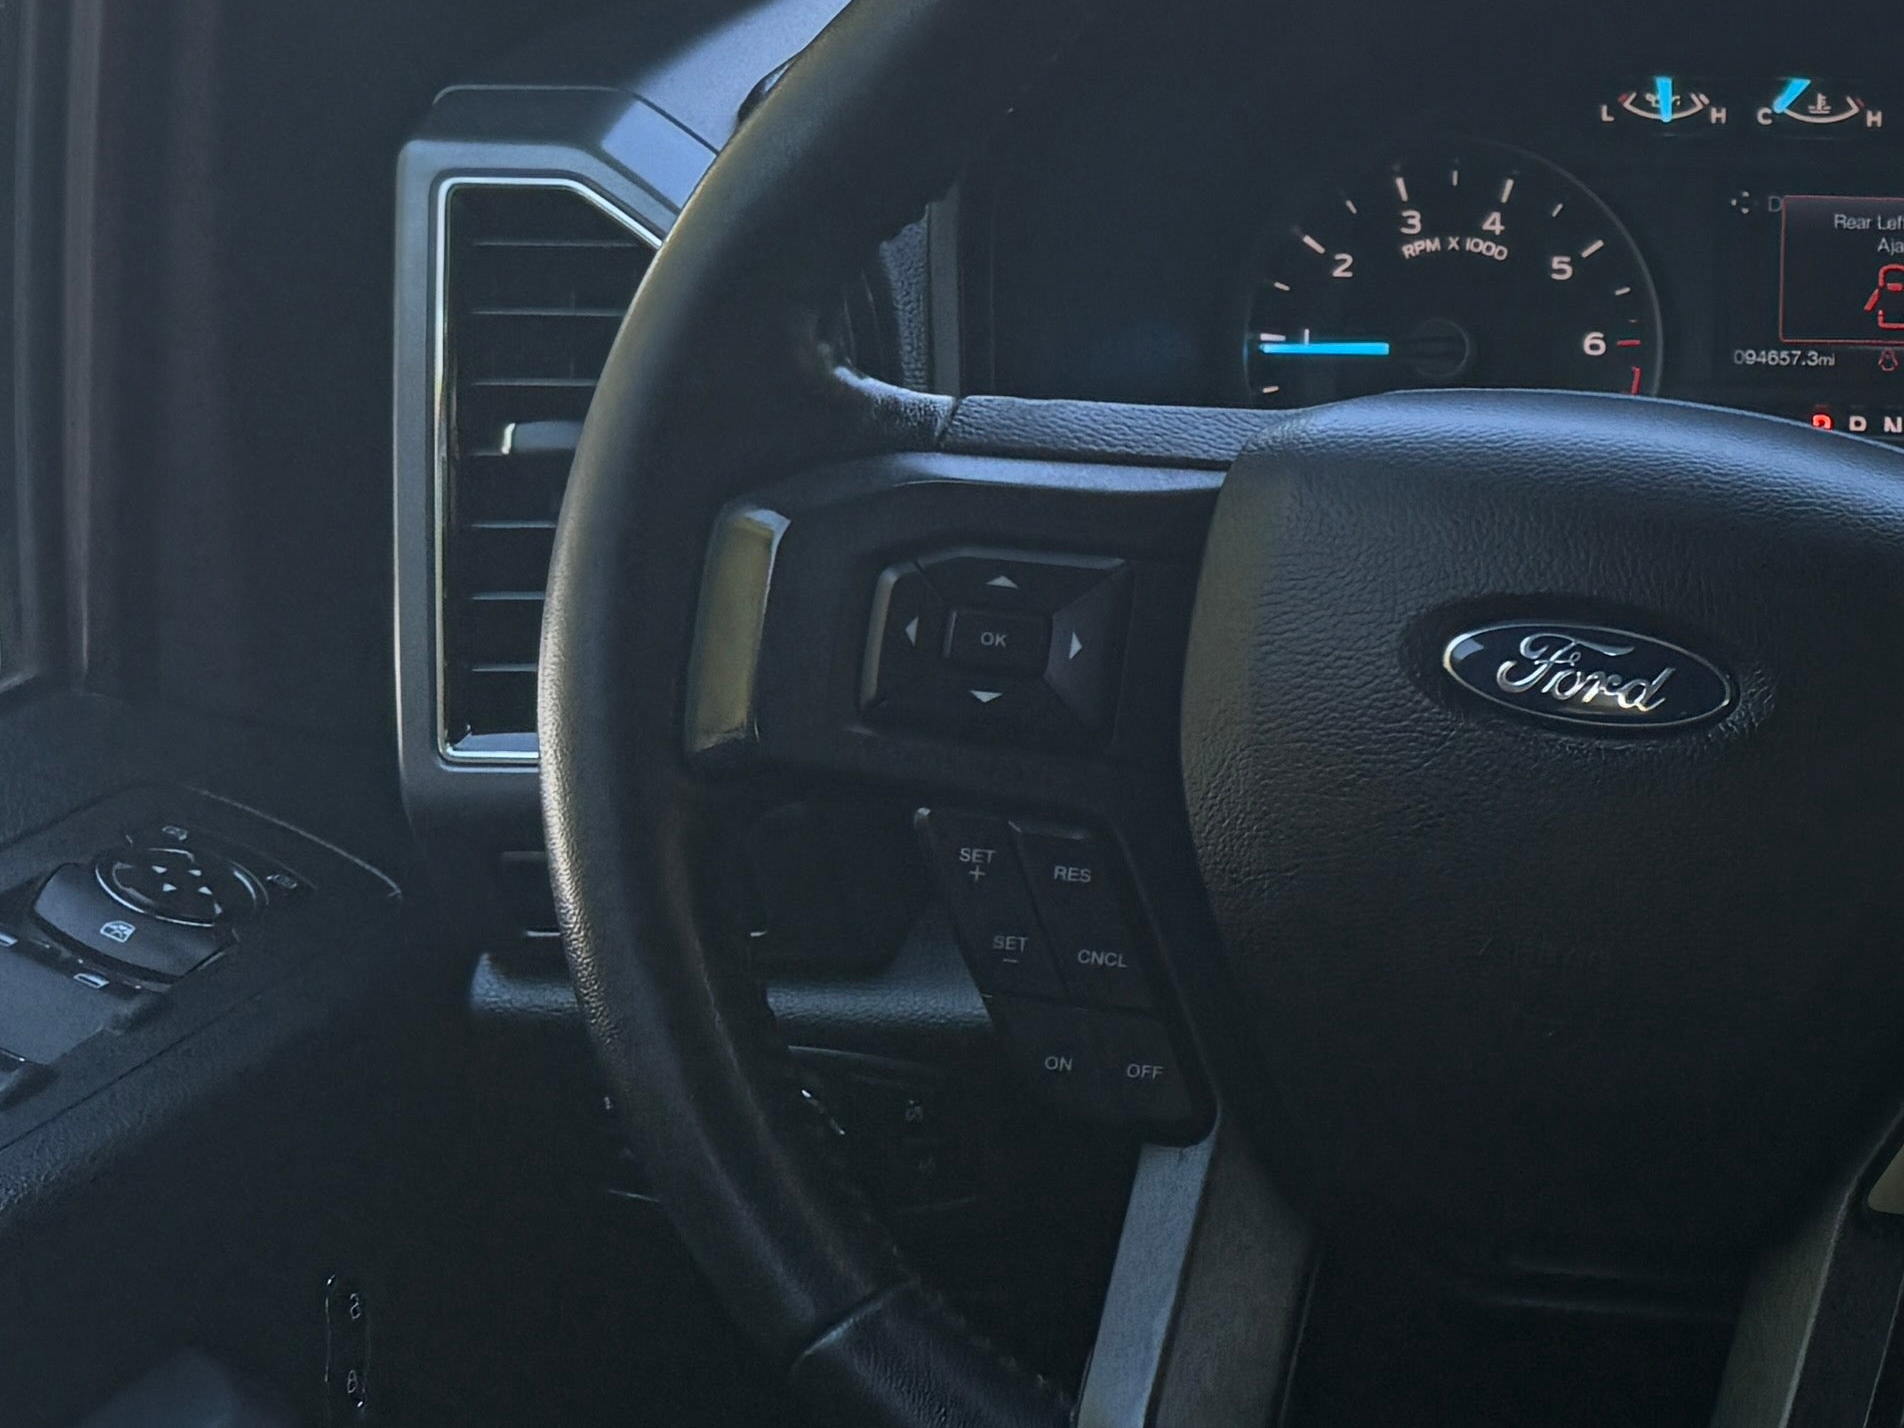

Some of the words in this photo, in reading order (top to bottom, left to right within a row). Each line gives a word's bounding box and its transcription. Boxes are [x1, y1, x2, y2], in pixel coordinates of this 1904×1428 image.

[1601, 105, 1614, 121] L
[1710, 108, 1726, 124] H
[1757, 108, 1772, 125] C
[1866, 110, 1882, 127] H
[1400, 209, 1422, 235] 3
[1482, 211, 1505, 236] 4
[1834, 214, 1872, 230] Rear
[1401, 237, 1441, 261] RPM
[1448, 236, 1460, 251] X
[1465, 237, 1509, 262] 1000
[1332, 253, 1353, 278] 2
[1550, 255, 1574, 281] 5
[1583, 331, 1606, 357] 6
[979, 631, 1007, 648] OK
[1496, 632, 1677, 713] Ford
[958, 846, 996, 866] SET
[1053, 865, 1092, 884] RES
[991, 934, 1029, 954] SET
[1077, 948, 1129, 969] CNCL
[1044, 1055, 1073, 1072] ON
[1125, 1063, 1164, 1080] OFF
